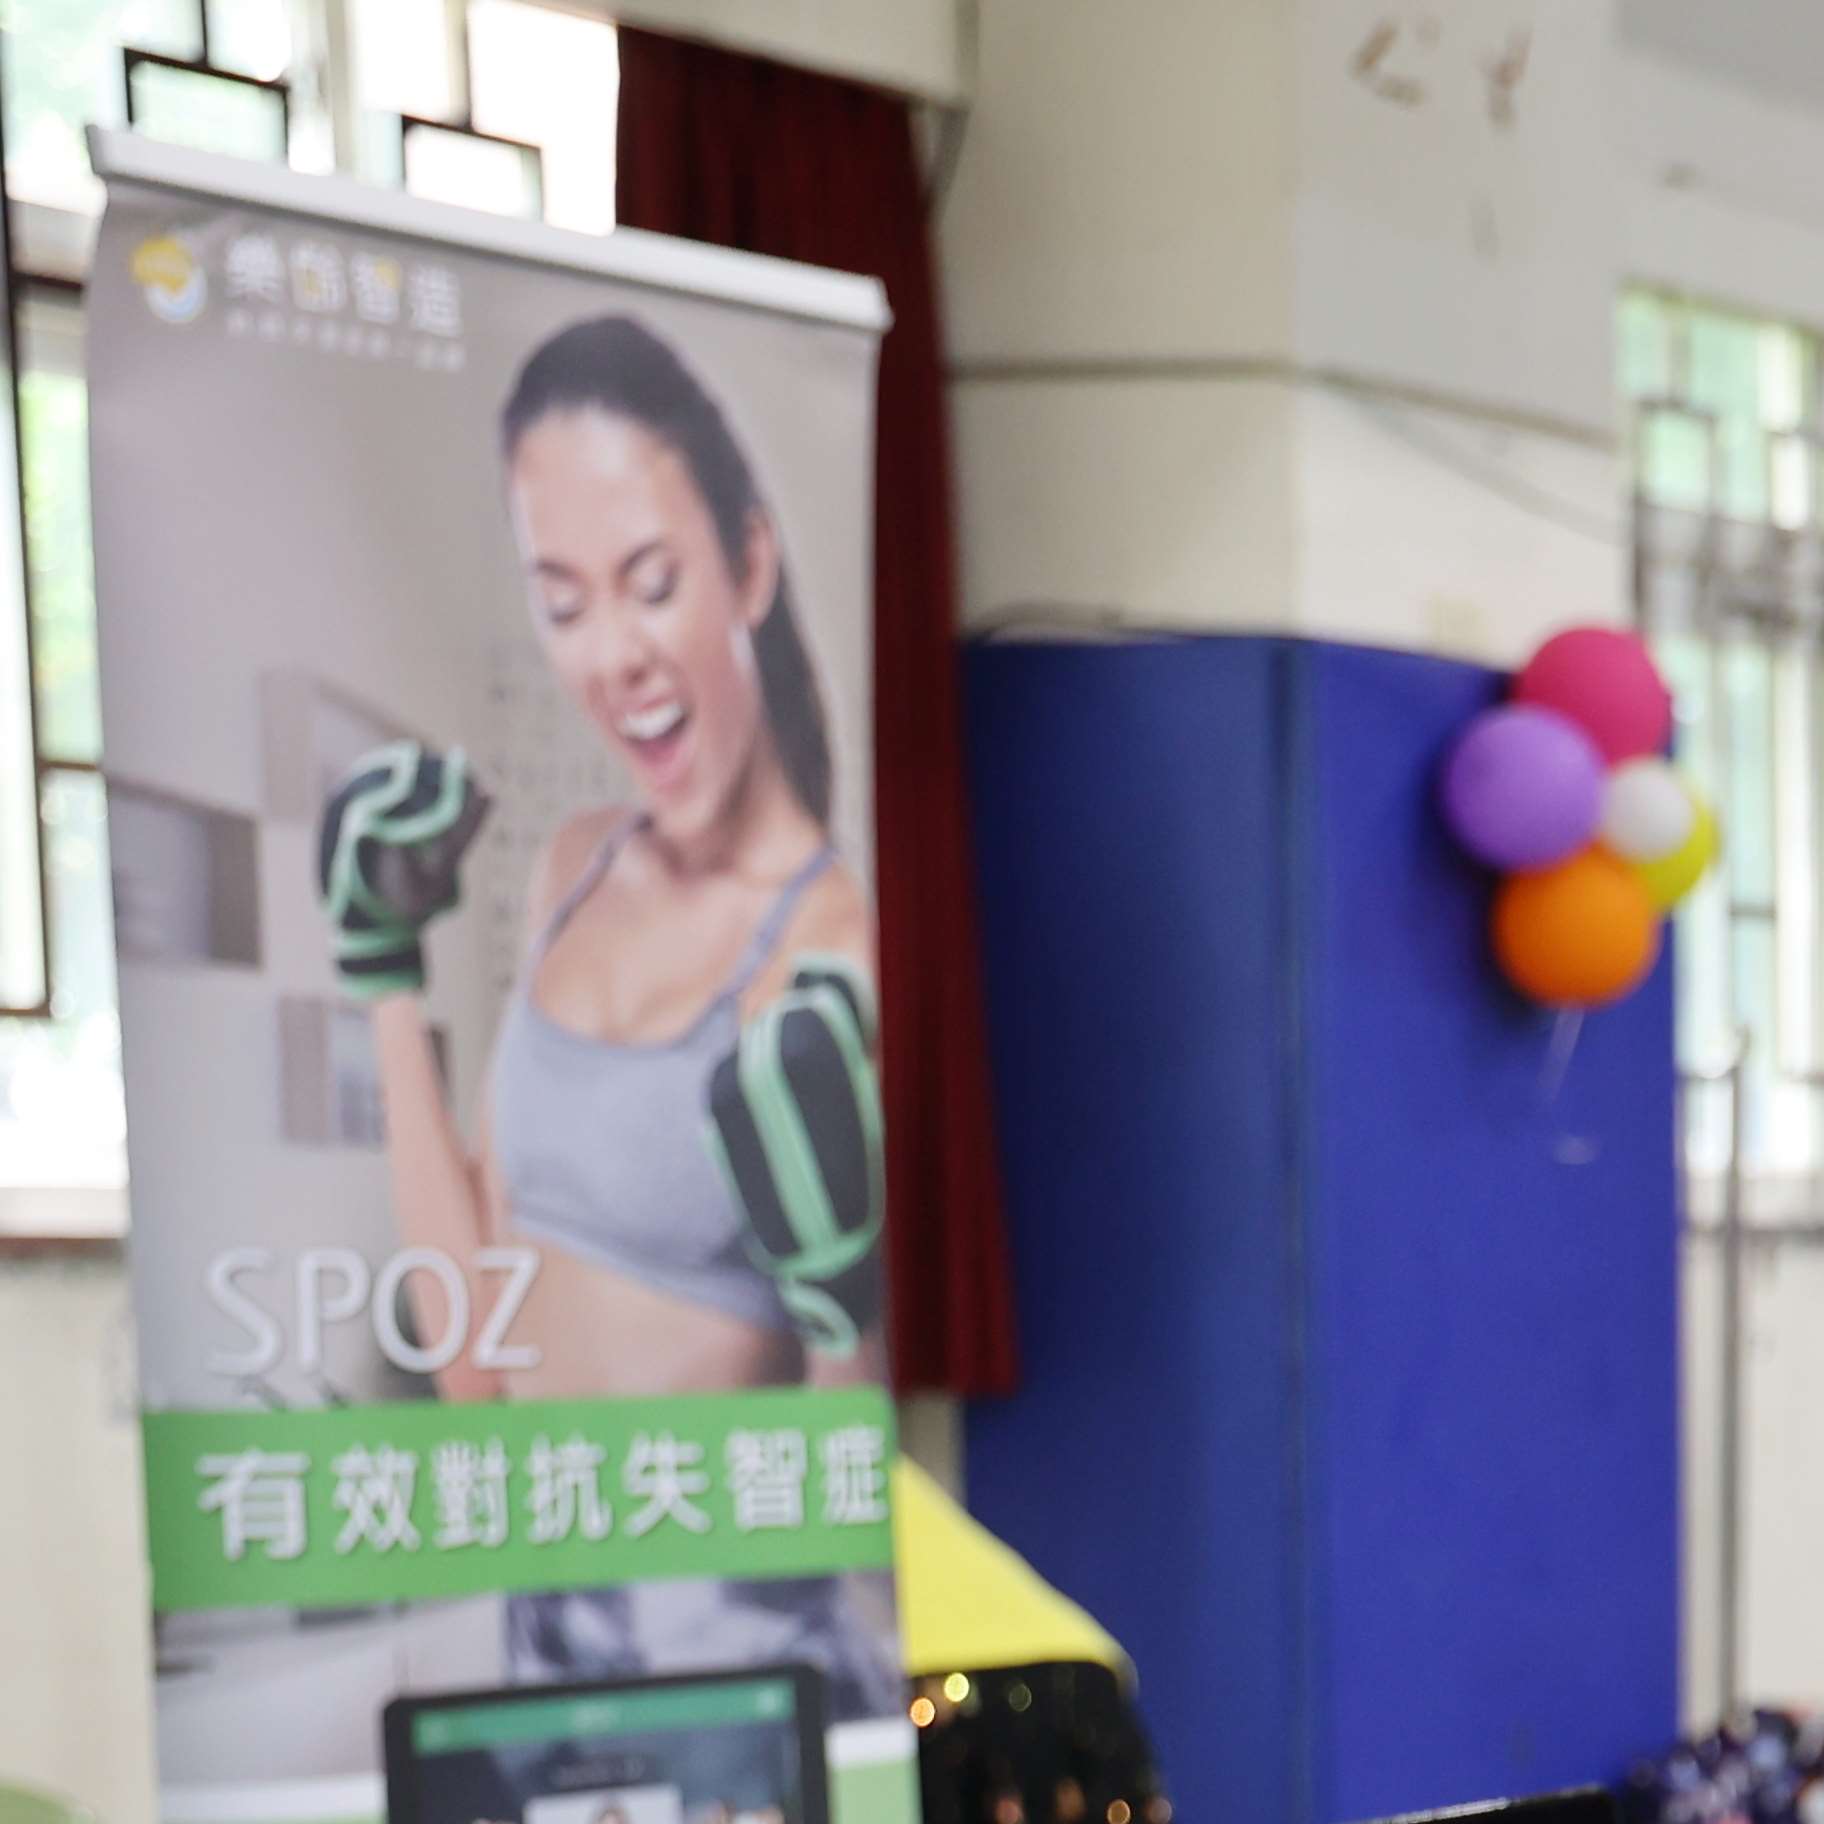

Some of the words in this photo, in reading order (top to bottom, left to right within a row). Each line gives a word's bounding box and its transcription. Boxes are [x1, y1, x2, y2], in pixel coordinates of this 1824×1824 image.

[206, 1249, 542, 1371] SPOZ
[199, 1428, 890, 1560] 有效對抗失智症
